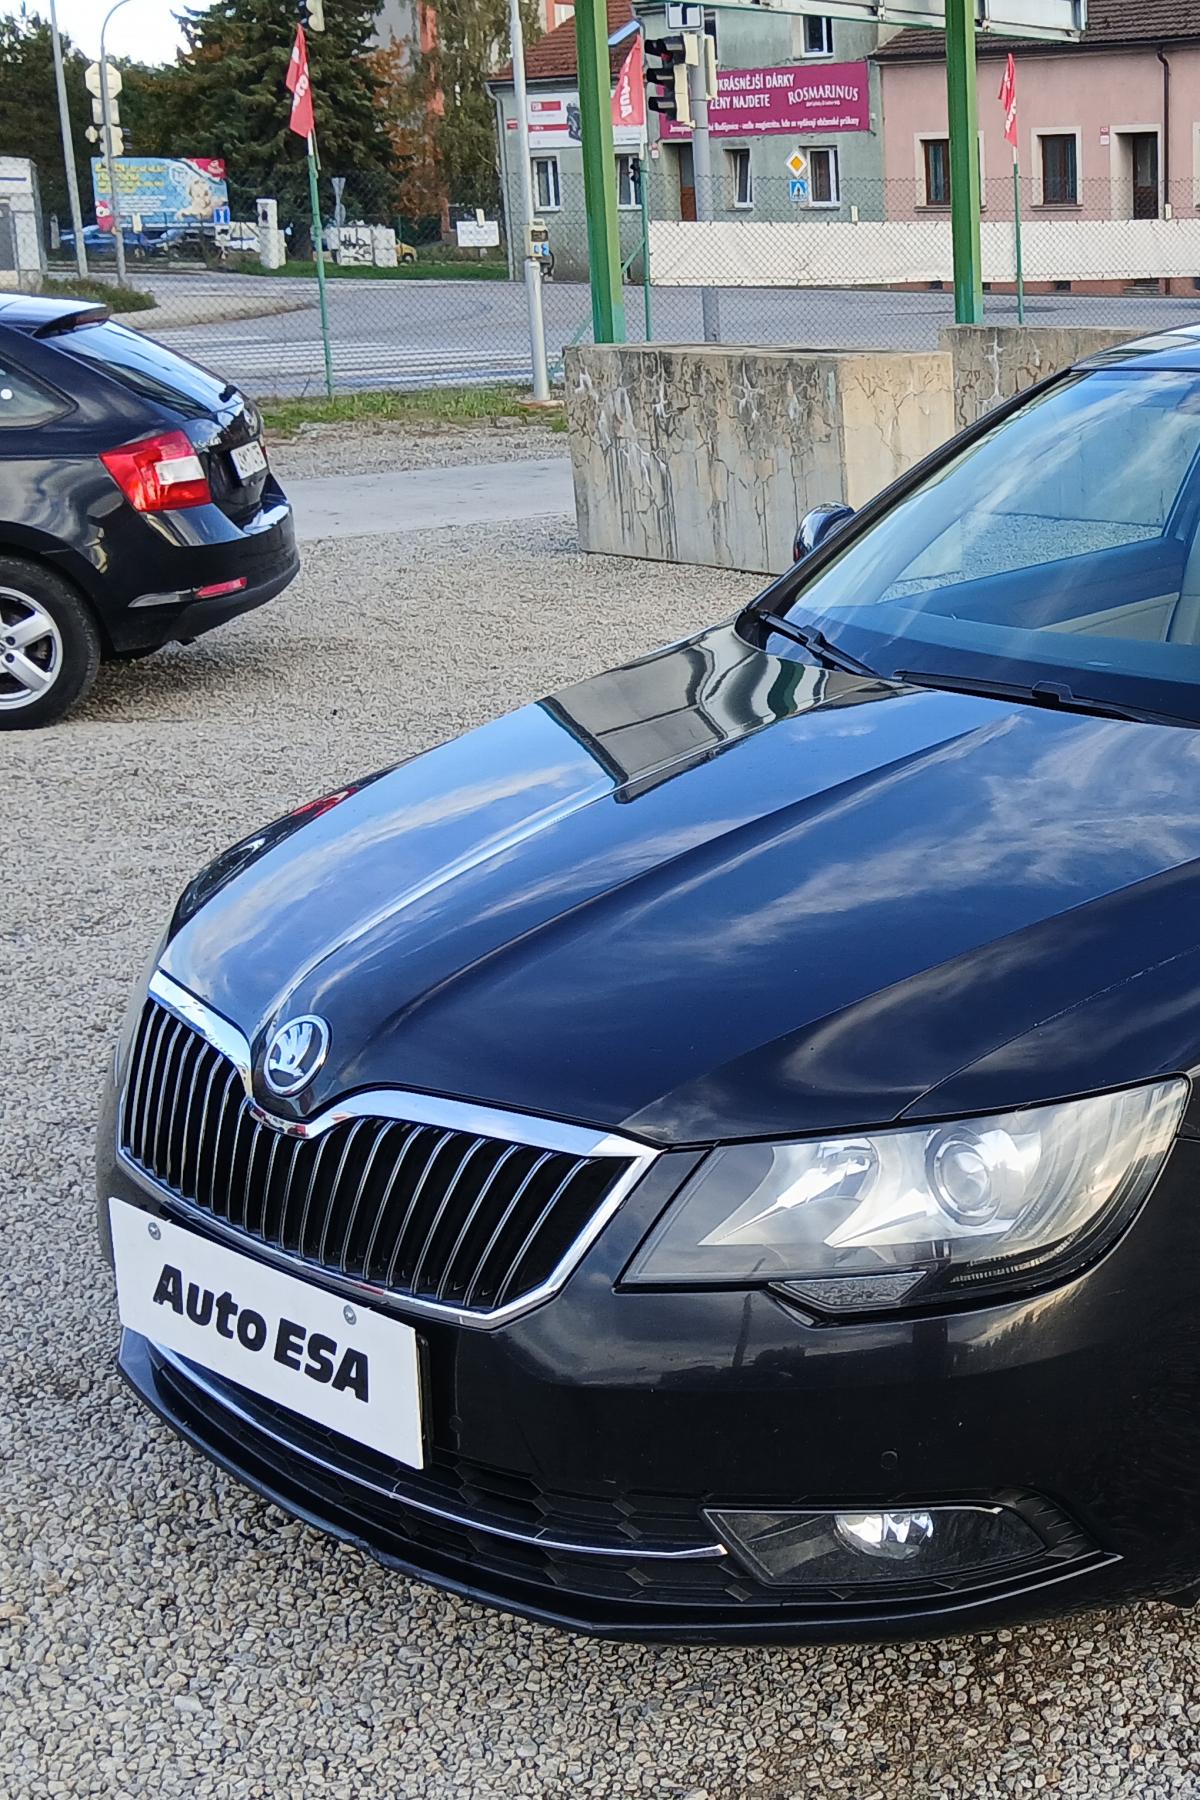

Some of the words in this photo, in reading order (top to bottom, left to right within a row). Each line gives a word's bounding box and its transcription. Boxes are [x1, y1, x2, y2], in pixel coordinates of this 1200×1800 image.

[716, 73, 764, 92] KRÁSNĚJŠÍ
[765, 72, 795, 88] DÁRKY
[732, 93, 771, 109] NAJDETE
[787, 84, 859, 106] ROSMARINUS
[152, 1263, 268, 1352] Auto
[273, 1317, 369, 1404] ESA
